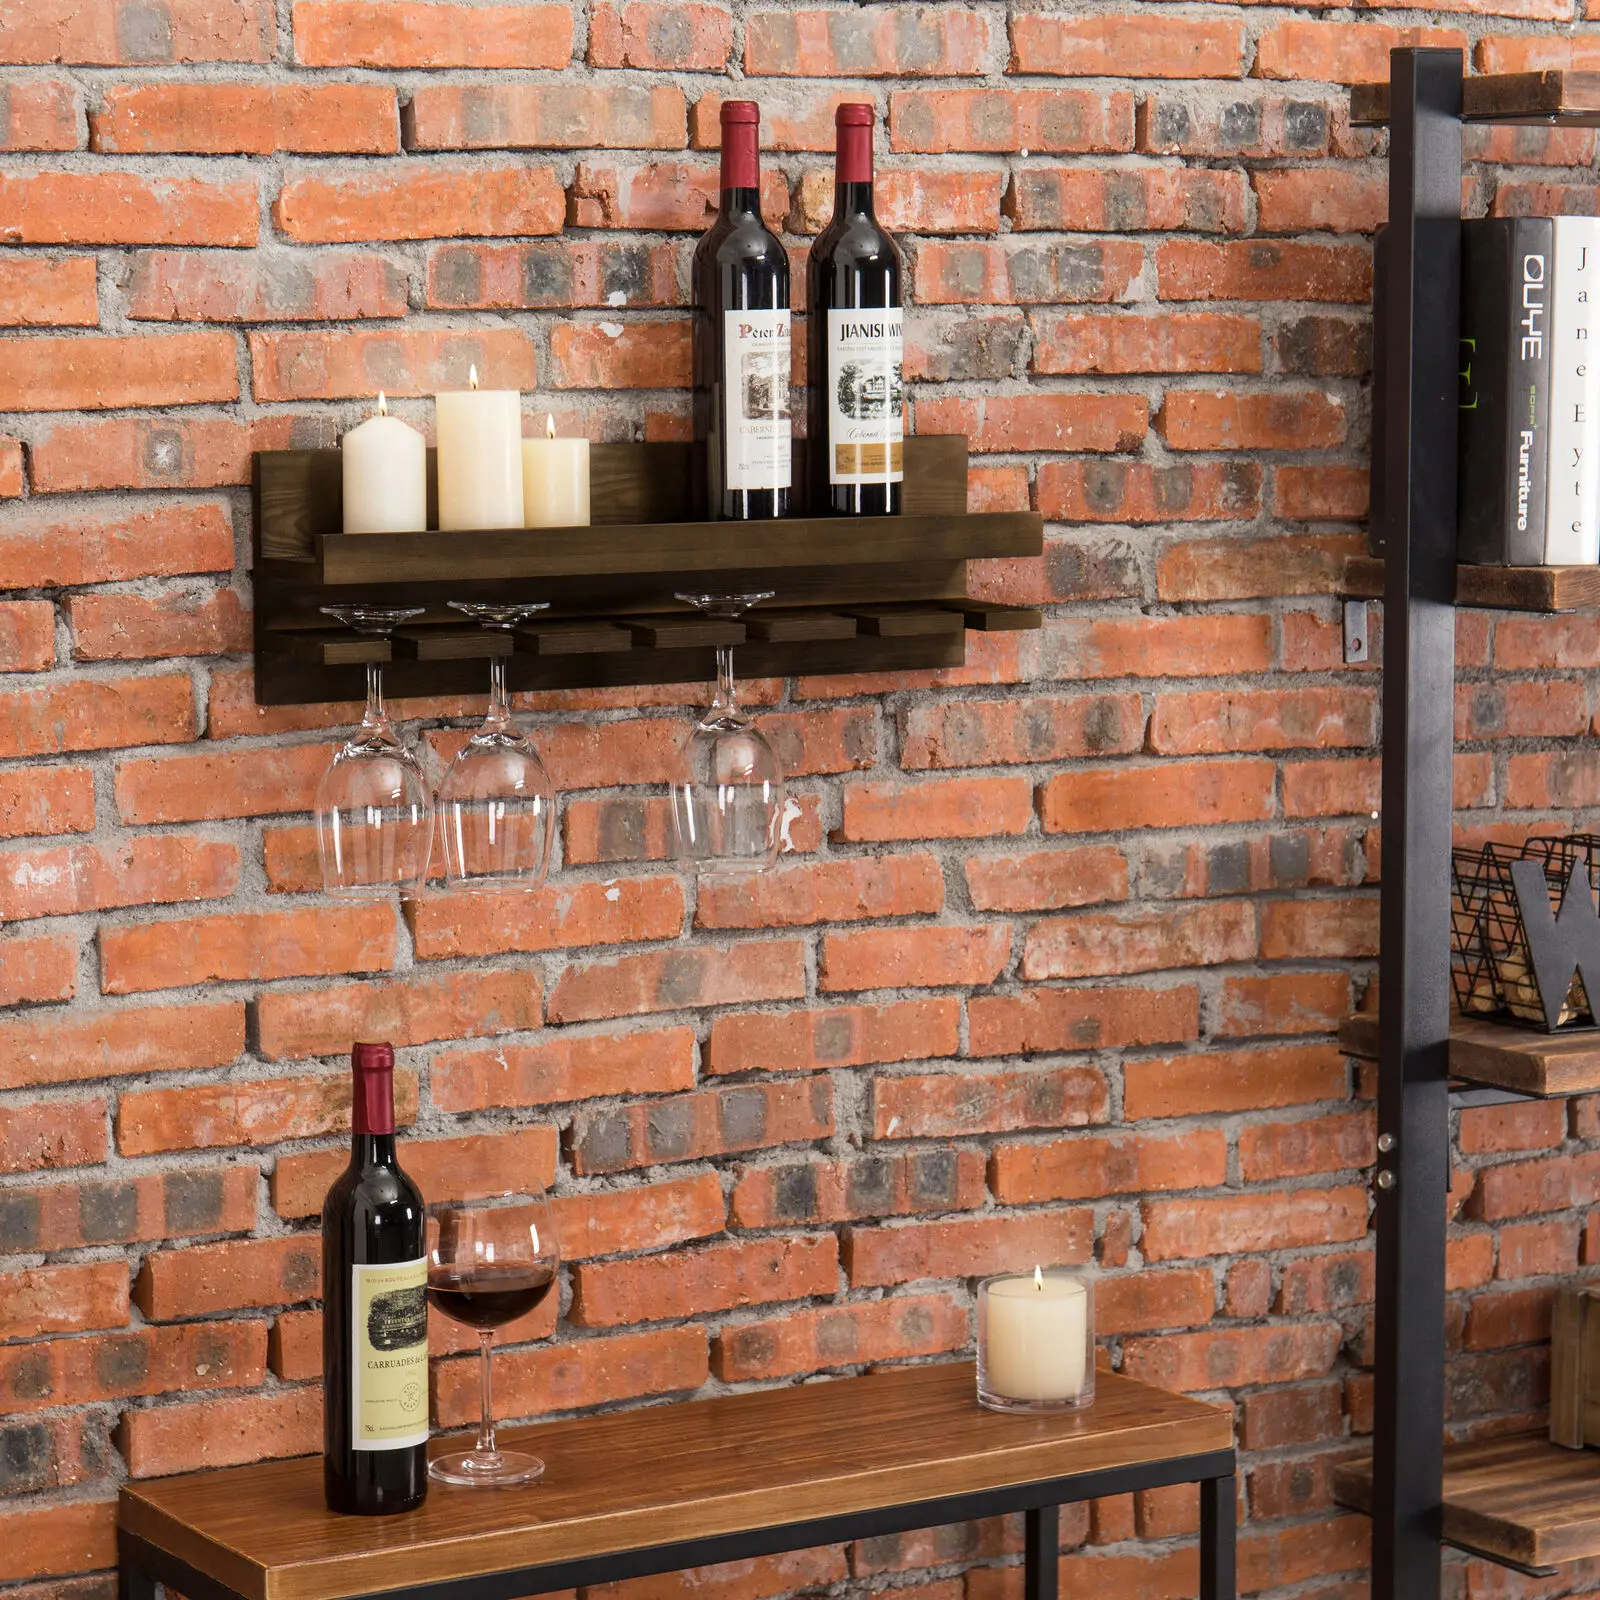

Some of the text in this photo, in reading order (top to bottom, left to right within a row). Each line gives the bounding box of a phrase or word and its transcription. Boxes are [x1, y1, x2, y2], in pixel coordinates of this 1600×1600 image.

[739, 323, 774, 339] Peter
[840, 323, 884, 341] JIANISI
[1521, 255, 1544, 360] OUYE
[1576, 247, 1588, 376] Jane
[1517, 431, 1533, 531] Furniture
[367, 1357, 414, 1369] CARRUADES
